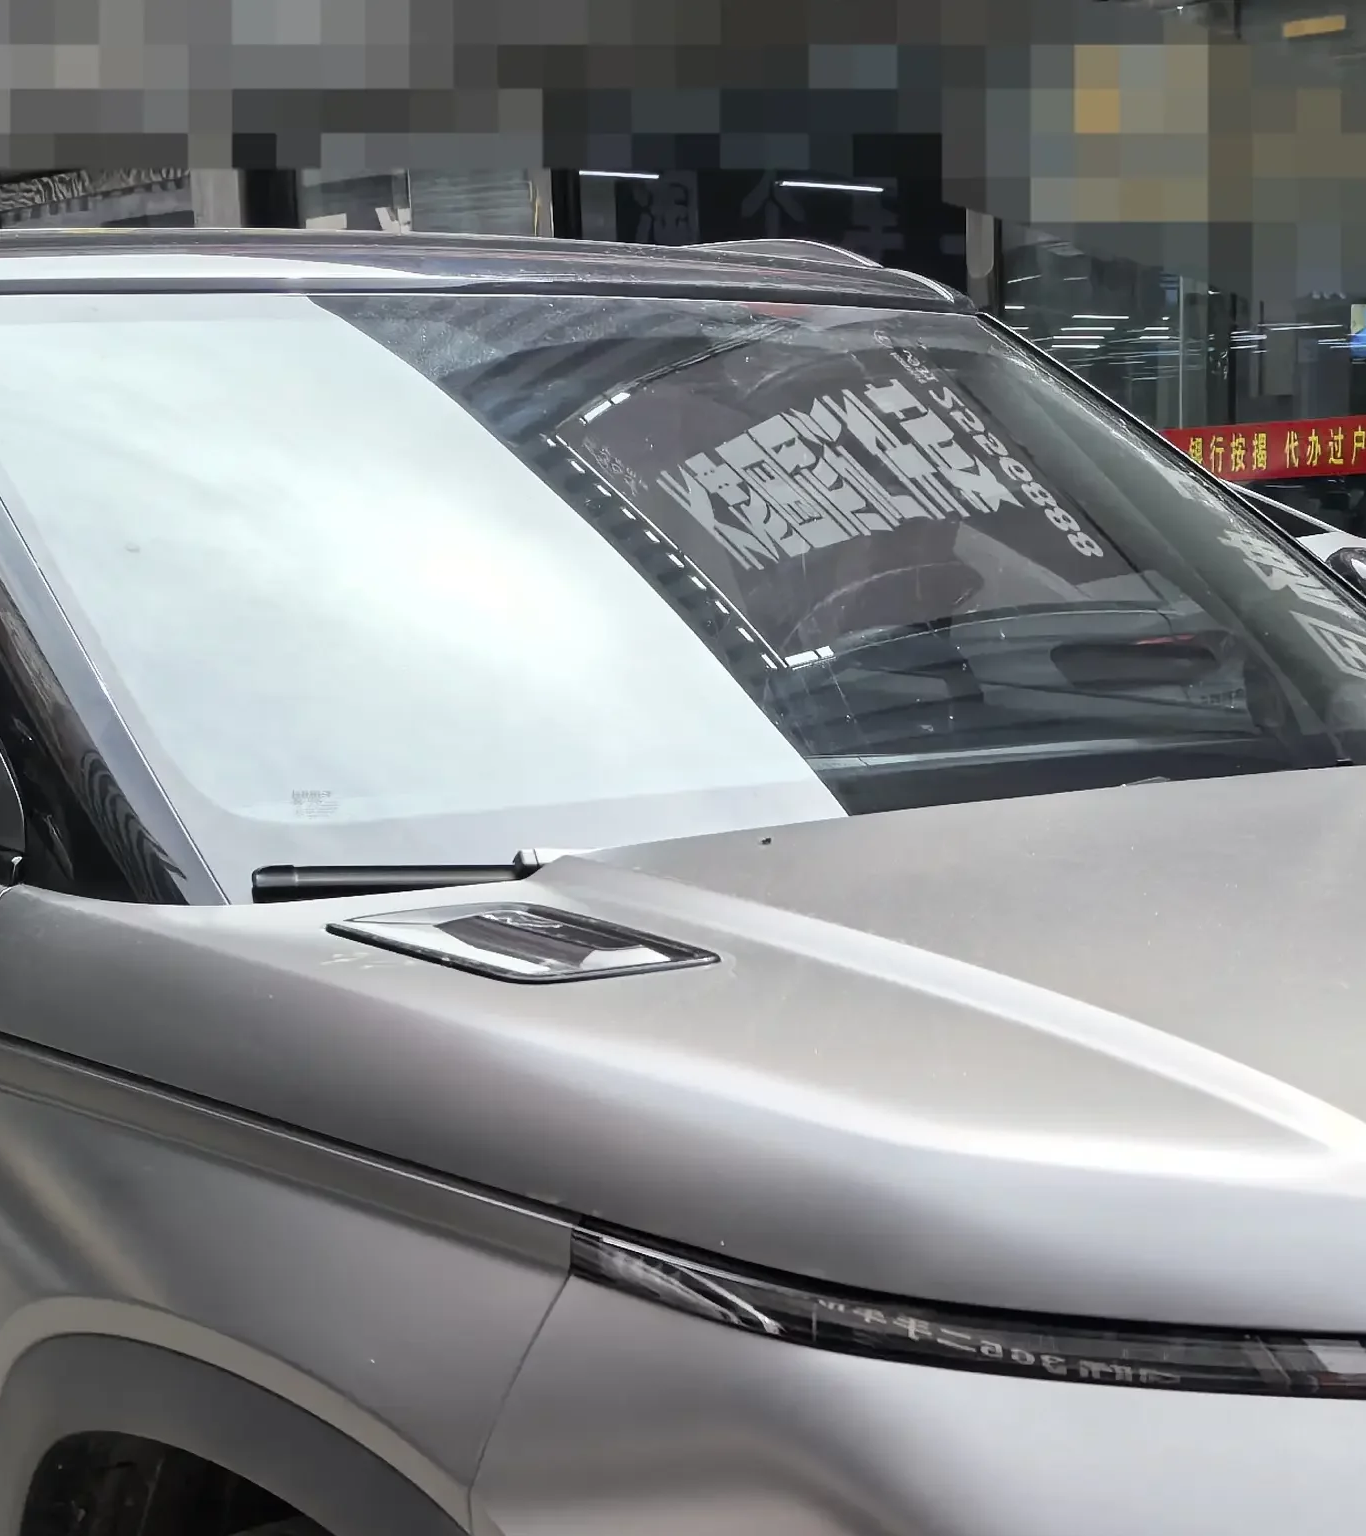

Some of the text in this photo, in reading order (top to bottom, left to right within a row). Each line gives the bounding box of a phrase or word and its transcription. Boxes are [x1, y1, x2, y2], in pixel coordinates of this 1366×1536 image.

[1188, 424, 1366, 473] 银行按揭 代办过户
